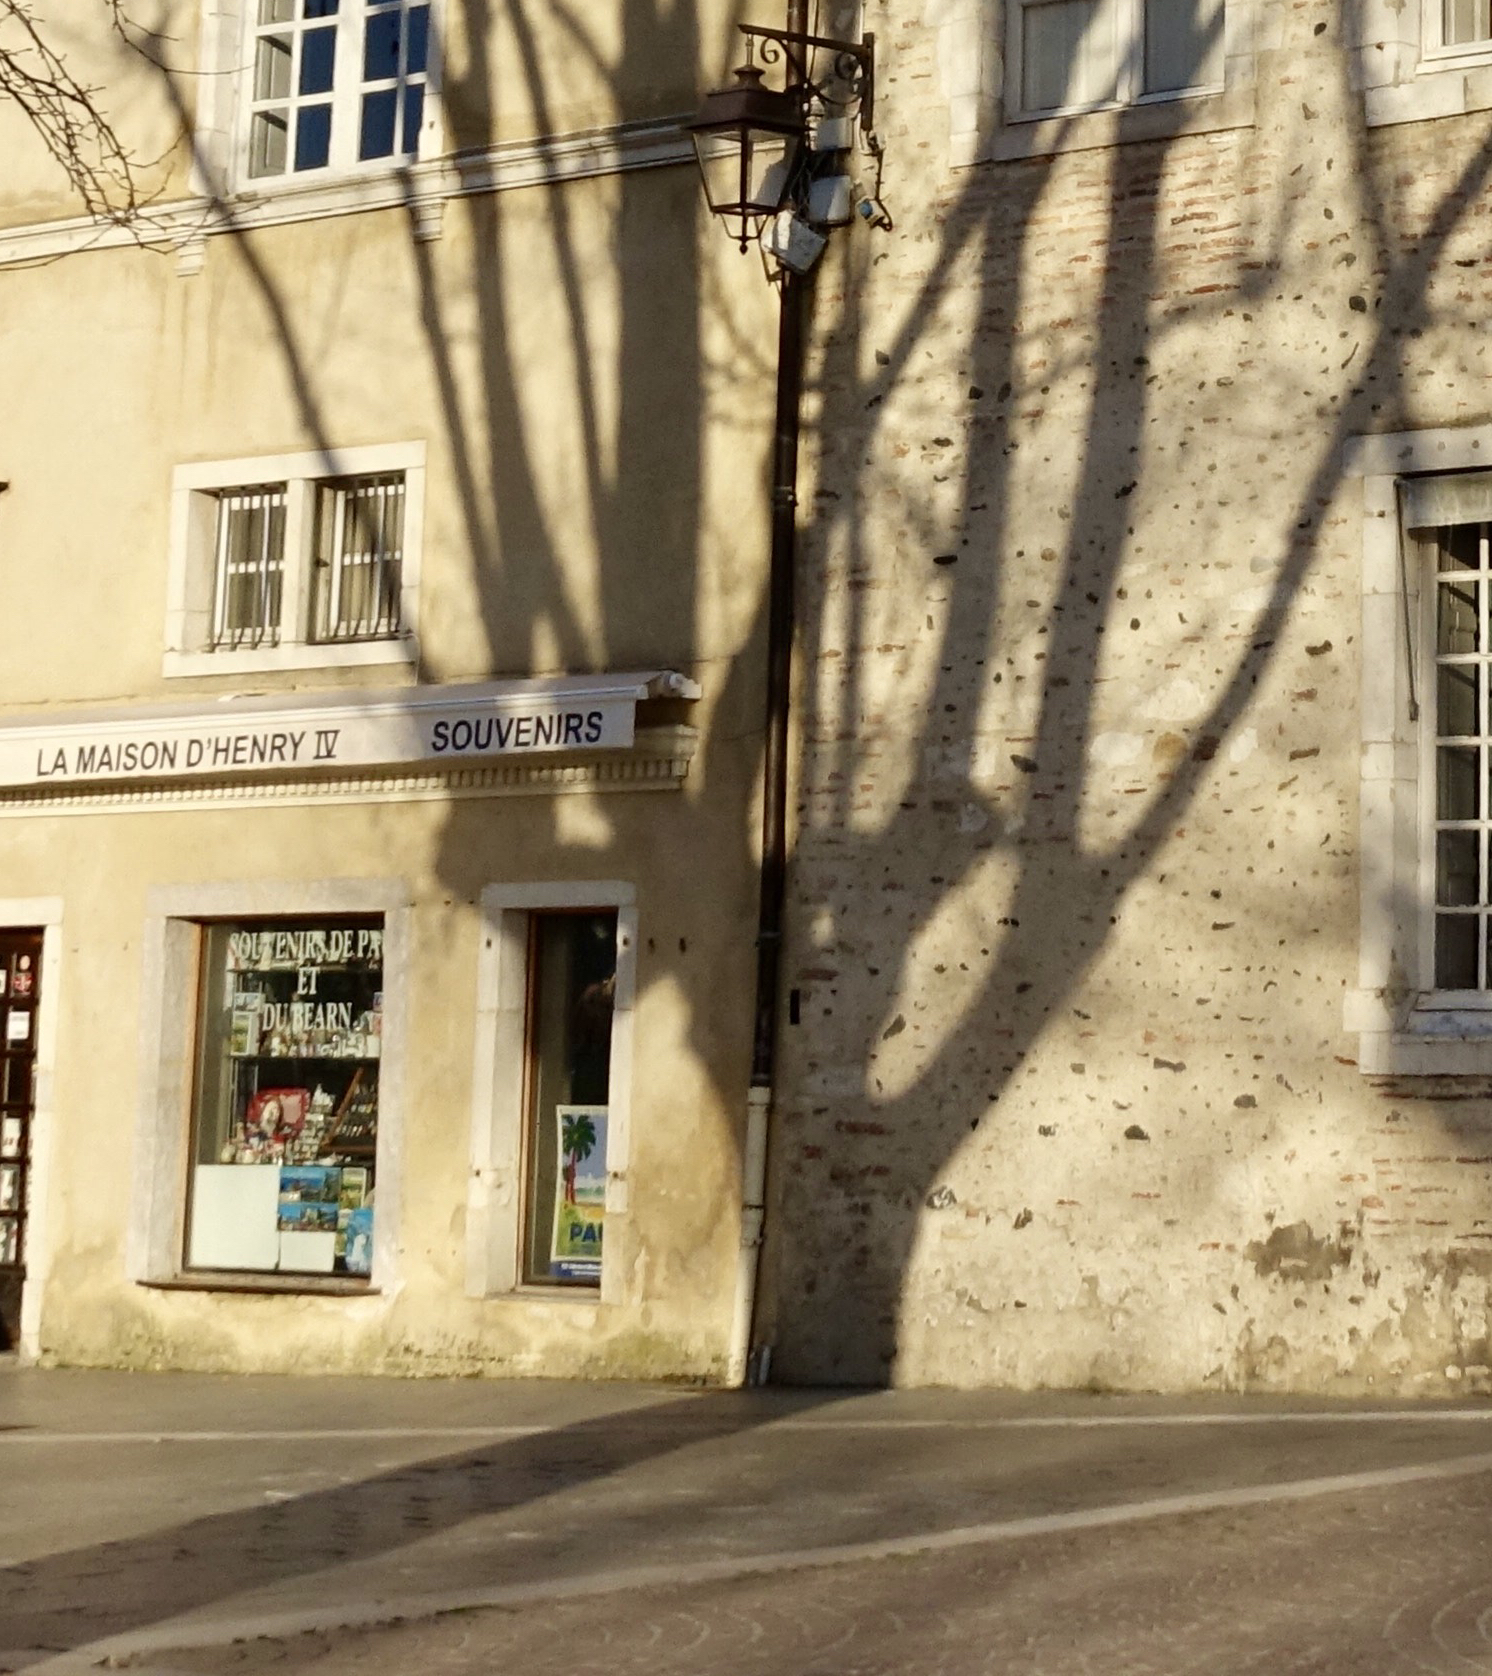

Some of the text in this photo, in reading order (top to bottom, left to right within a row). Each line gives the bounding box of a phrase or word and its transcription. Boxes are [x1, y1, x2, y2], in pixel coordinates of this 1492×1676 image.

[431, 711, 604, 752] SOUVENIRS
[36, 748, 68, 777] LA
[75, 740, 178, 774] MAISON
[313, 729, 341, 760] IV
[229, 929, 382, 961] SOUVENIRS DE PA
[297, 965, 320, 995] ET
[262, 1001, 353, 1032] DU BEARN
